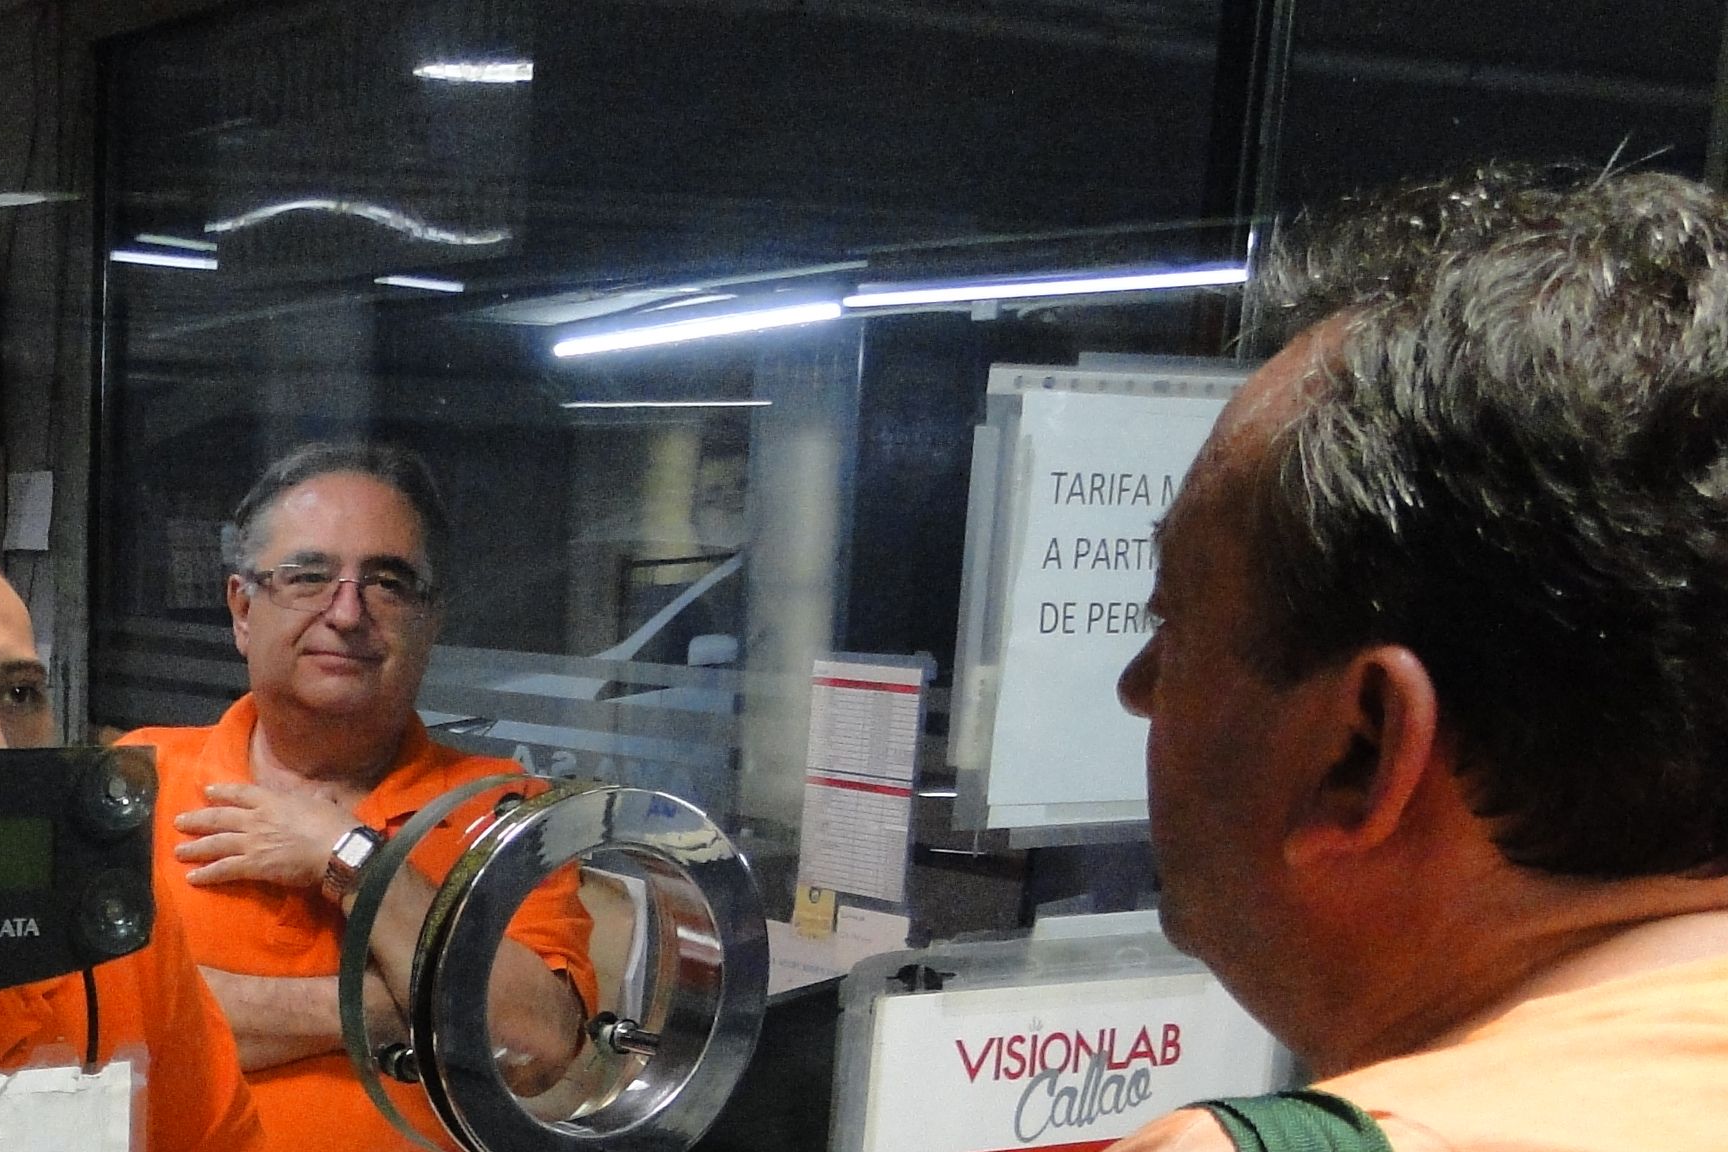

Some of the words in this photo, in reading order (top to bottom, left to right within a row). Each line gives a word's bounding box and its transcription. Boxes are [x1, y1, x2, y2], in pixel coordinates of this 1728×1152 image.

[1050, 472, 1151, 506] TARIFA
[1042, 538, 1062, 570] A
[1039, 602, 1077, 634] DE
[955, 1023, 1182, 1083] VISIONLAB
[1014, 1050, 1153, 1143] Callao
